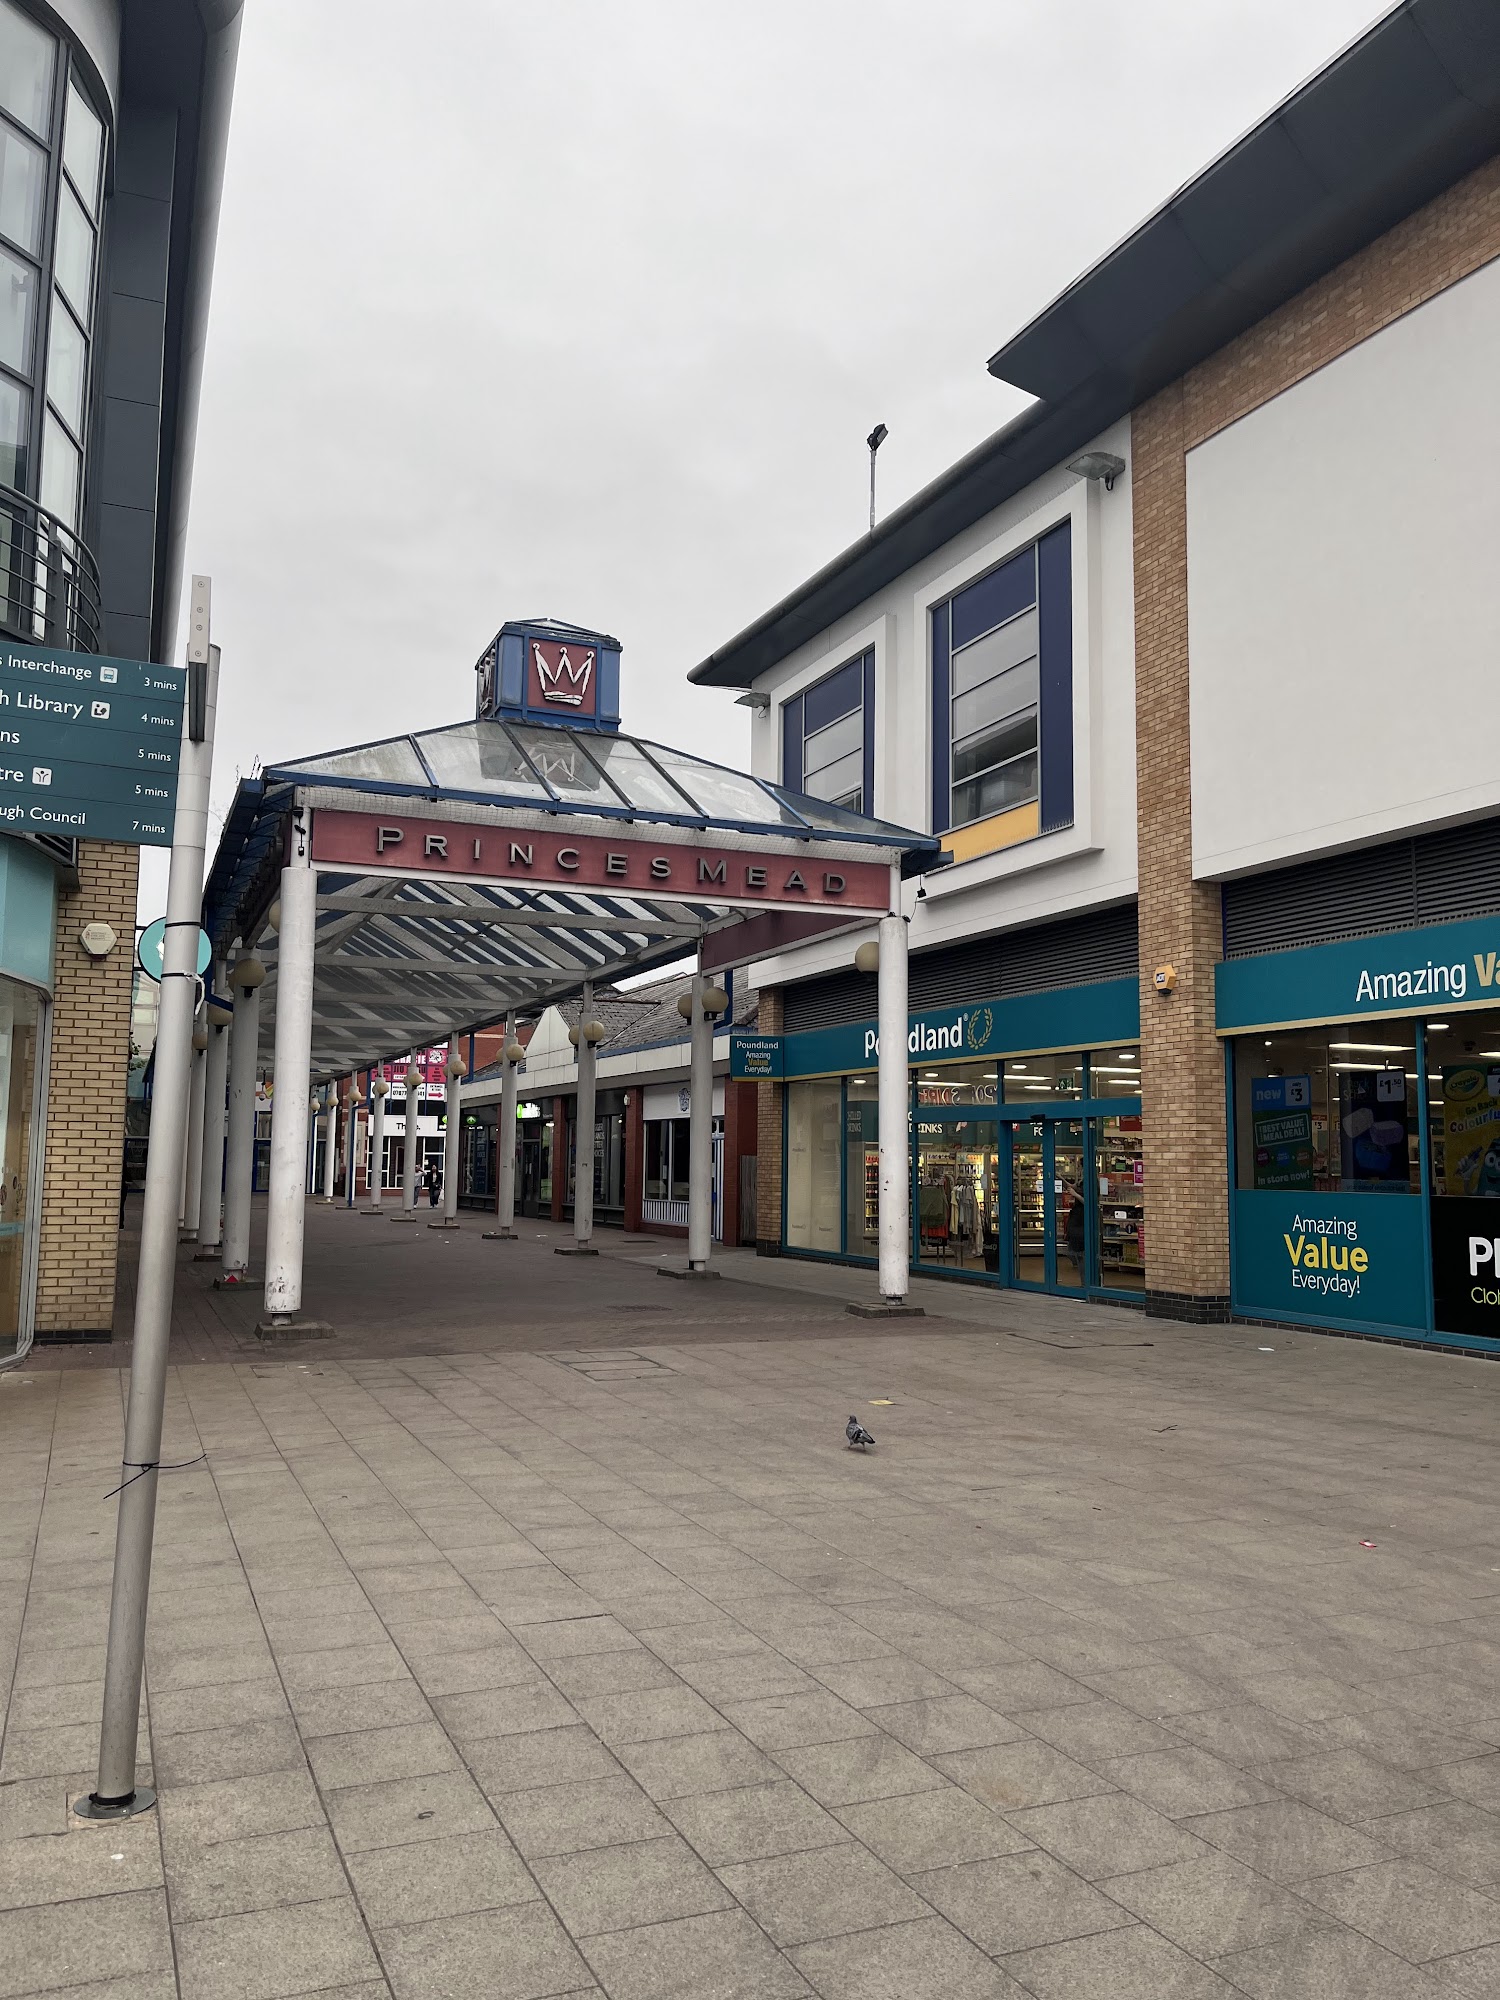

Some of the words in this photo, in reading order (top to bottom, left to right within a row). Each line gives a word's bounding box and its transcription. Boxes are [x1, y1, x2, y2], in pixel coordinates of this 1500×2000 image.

[8, 654, 92, 681] Interchange
[144, 677, 150, 687] 3
[153, 680, 177, 691] mins
[17, 691, 83, 720] Library
[141, 713, 148, 723] 4
[151, 715, 175, 727] mins
[138, 749, 145, 758] 5
[148, 751, 172, 762] mins
[135, 784, 141, 794] 5
[145, 787, 169, 798] mins
[30, 807, 86, 825] Council
[132, 821, 139, 830] 7
[142, 823, 166, 834] mins
[1355, 961, 1467, 1002] Amazing
[736, 1040, 779, 1049] Poundland
[865, 1017, 963, 1058] Pdland
[745, 1051, 771, 1060] Amazing
[748, 1058, 768, 1066] Value
[744, 1065, 773, 1074] Everyday!
[1256, 1088, 1282, 1100] new
[1290, 1088, 1303, 1102] £3
[1466, 1106, 1477, 1115] Go
[1478, 1098, 1498, 1111] Back
[1262, 1123, 1280, 1133] BEST
[1281, 1119, 1304, 1130] VALUE
[1263, 1131, 1283, 1142] MEAL
[1283, 1127, 1305, 1139] DEAL!
[1257, 1176, 1265, 1185] In
[1266, 1173, 1289, 1183] store
[1290, 1170, 1310, 1181] now!
[1292, 1214, 1358, 1240] Amazing
[1284, 1234, 1369, 1273] Value
[1292, 1269, 1360, 1298] Everyday!
